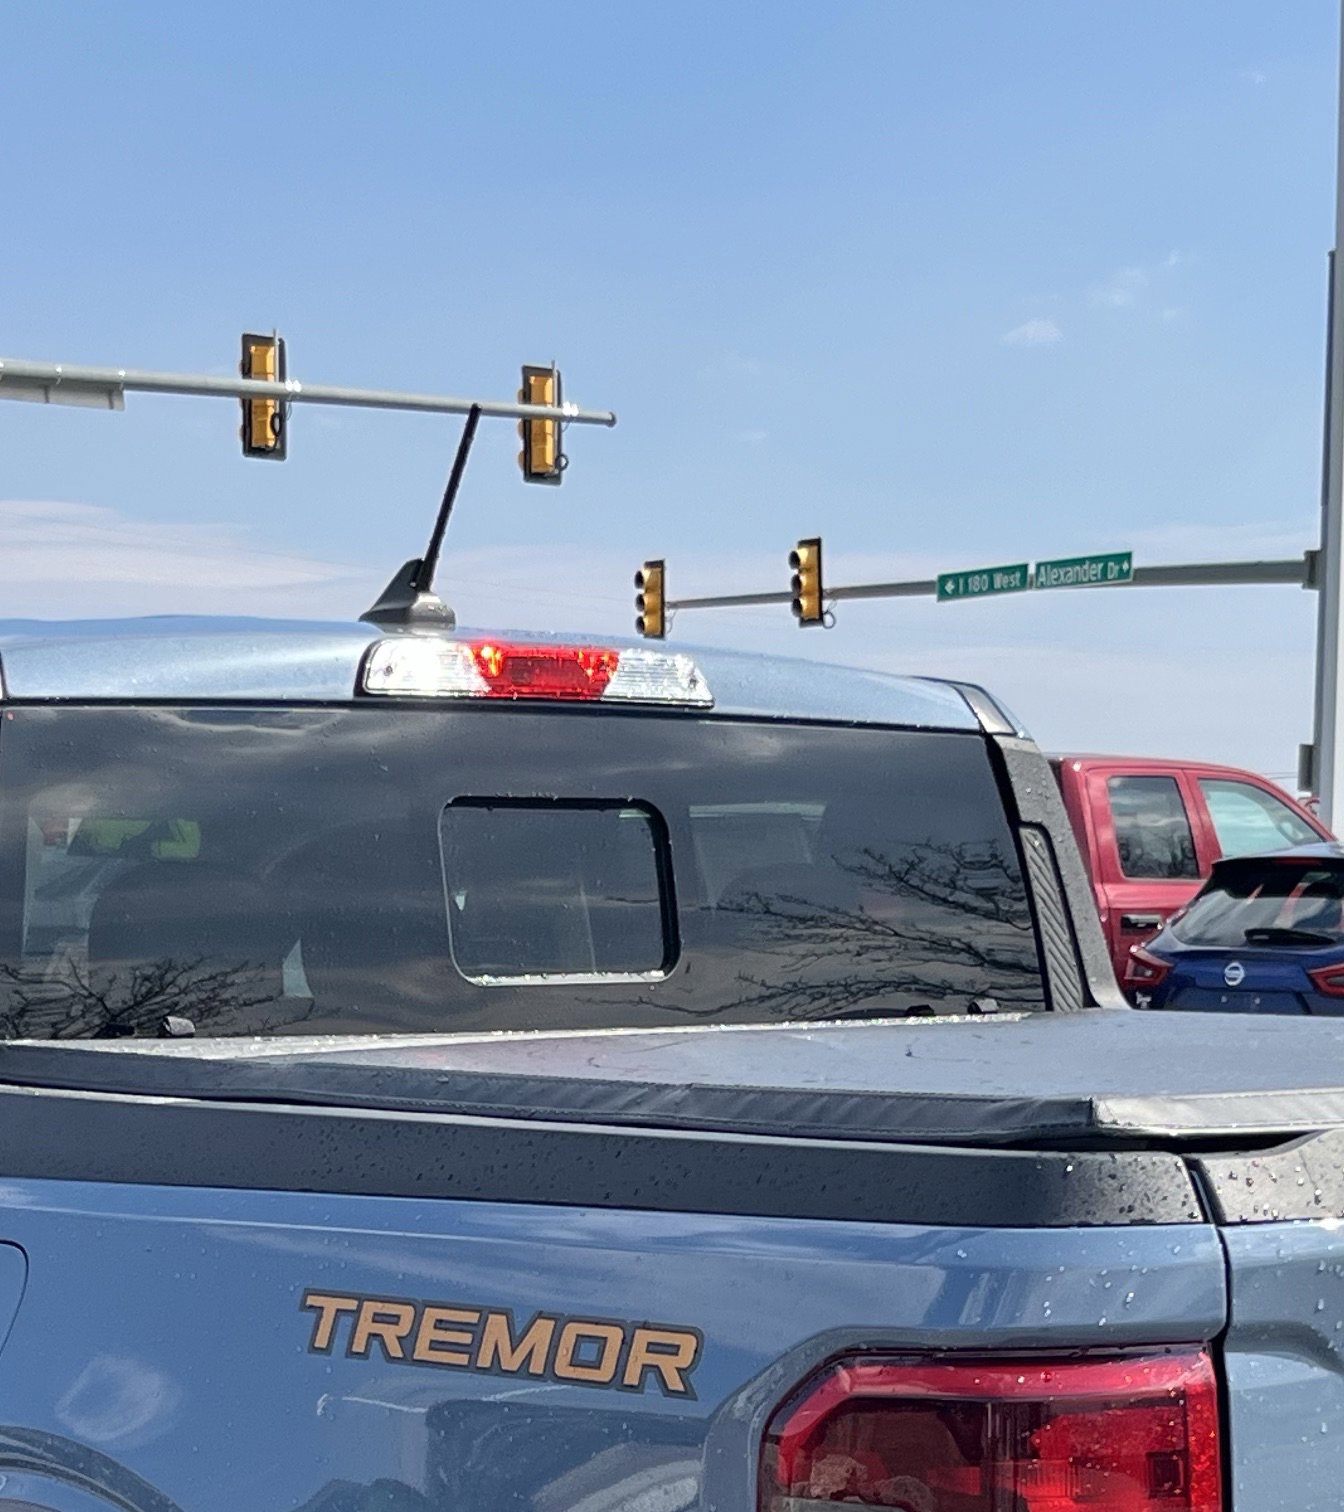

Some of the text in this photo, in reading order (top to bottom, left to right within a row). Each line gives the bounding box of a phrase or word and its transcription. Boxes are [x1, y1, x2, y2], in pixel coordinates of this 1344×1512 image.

[968, 574, 989, 593] 180
[993, 571, 1021, 590] West
[1036, 560, 1120, 587] Alexander Dr
[301, 1290, 702, 1398] TREMOR
